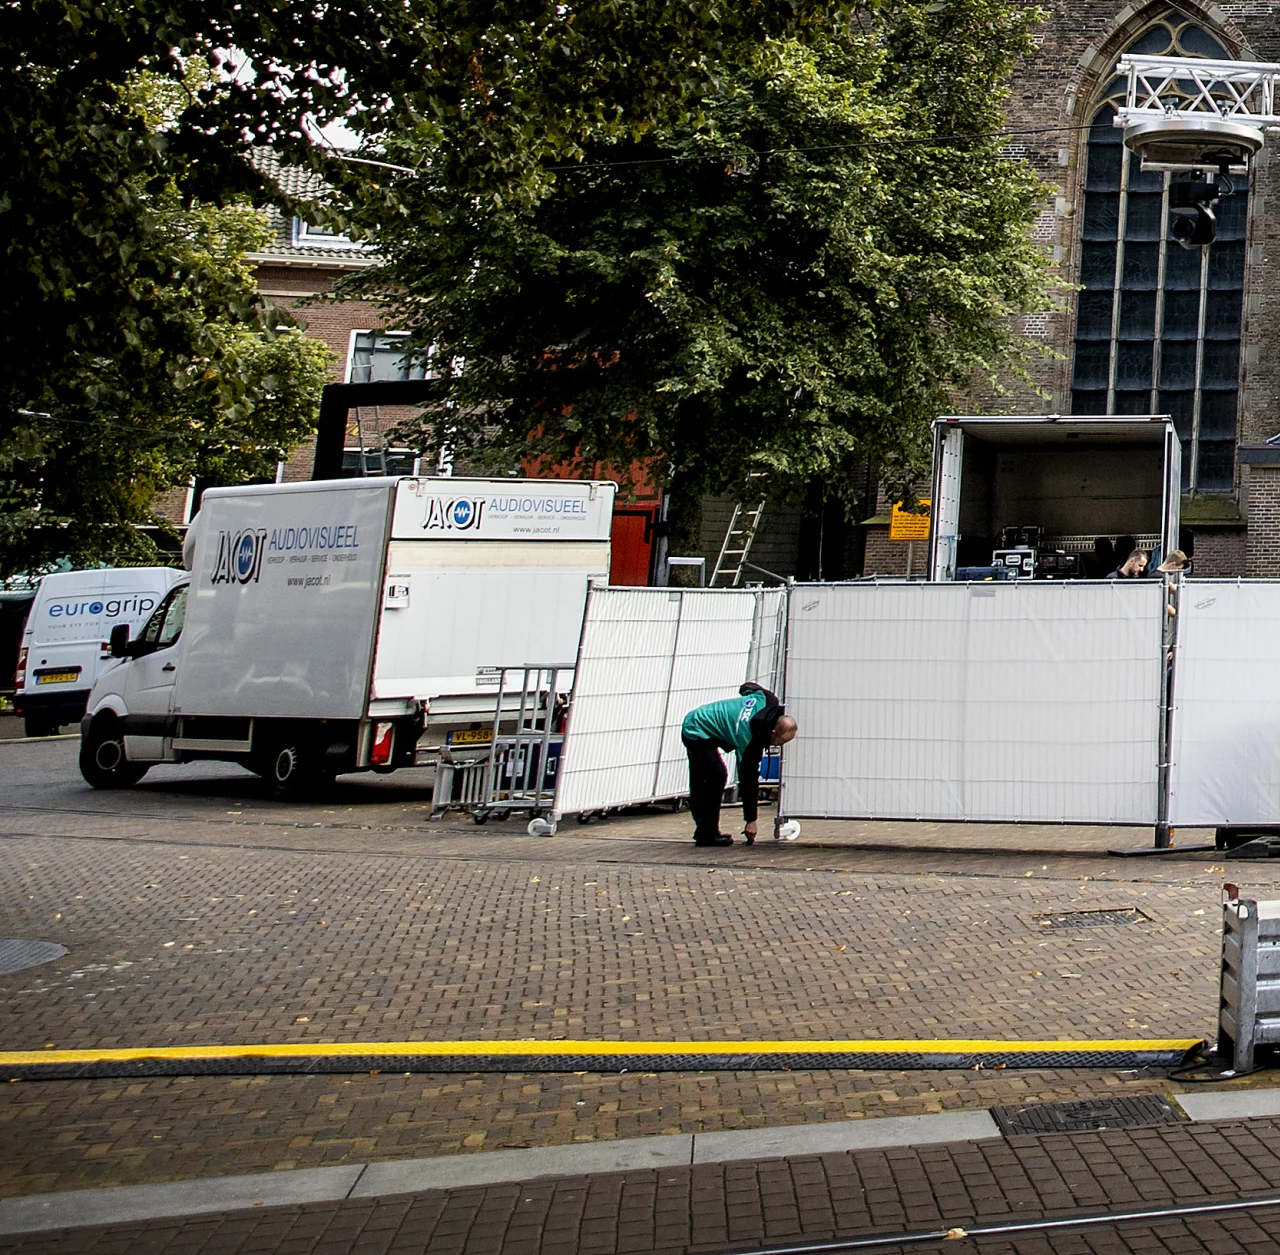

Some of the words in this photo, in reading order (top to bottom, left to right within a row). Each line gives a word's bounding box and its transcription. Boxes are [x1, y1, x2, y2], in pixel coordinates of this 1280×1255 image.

[420, 496, 486, 530] JACOT
[488, 498, 587, 513] AUDIOVISUEEL
[513, 526, 560, 534] www.jacot.nl
[211, 528, 267, 585] JACOT
[269, 526, 360, 551] AUDIOVISUEEL
[287, 574, 331, 588] www.jacot.nl
[49, 595, 154, 618] eurogrip
[456, 730, 493, 741] VL-958-
